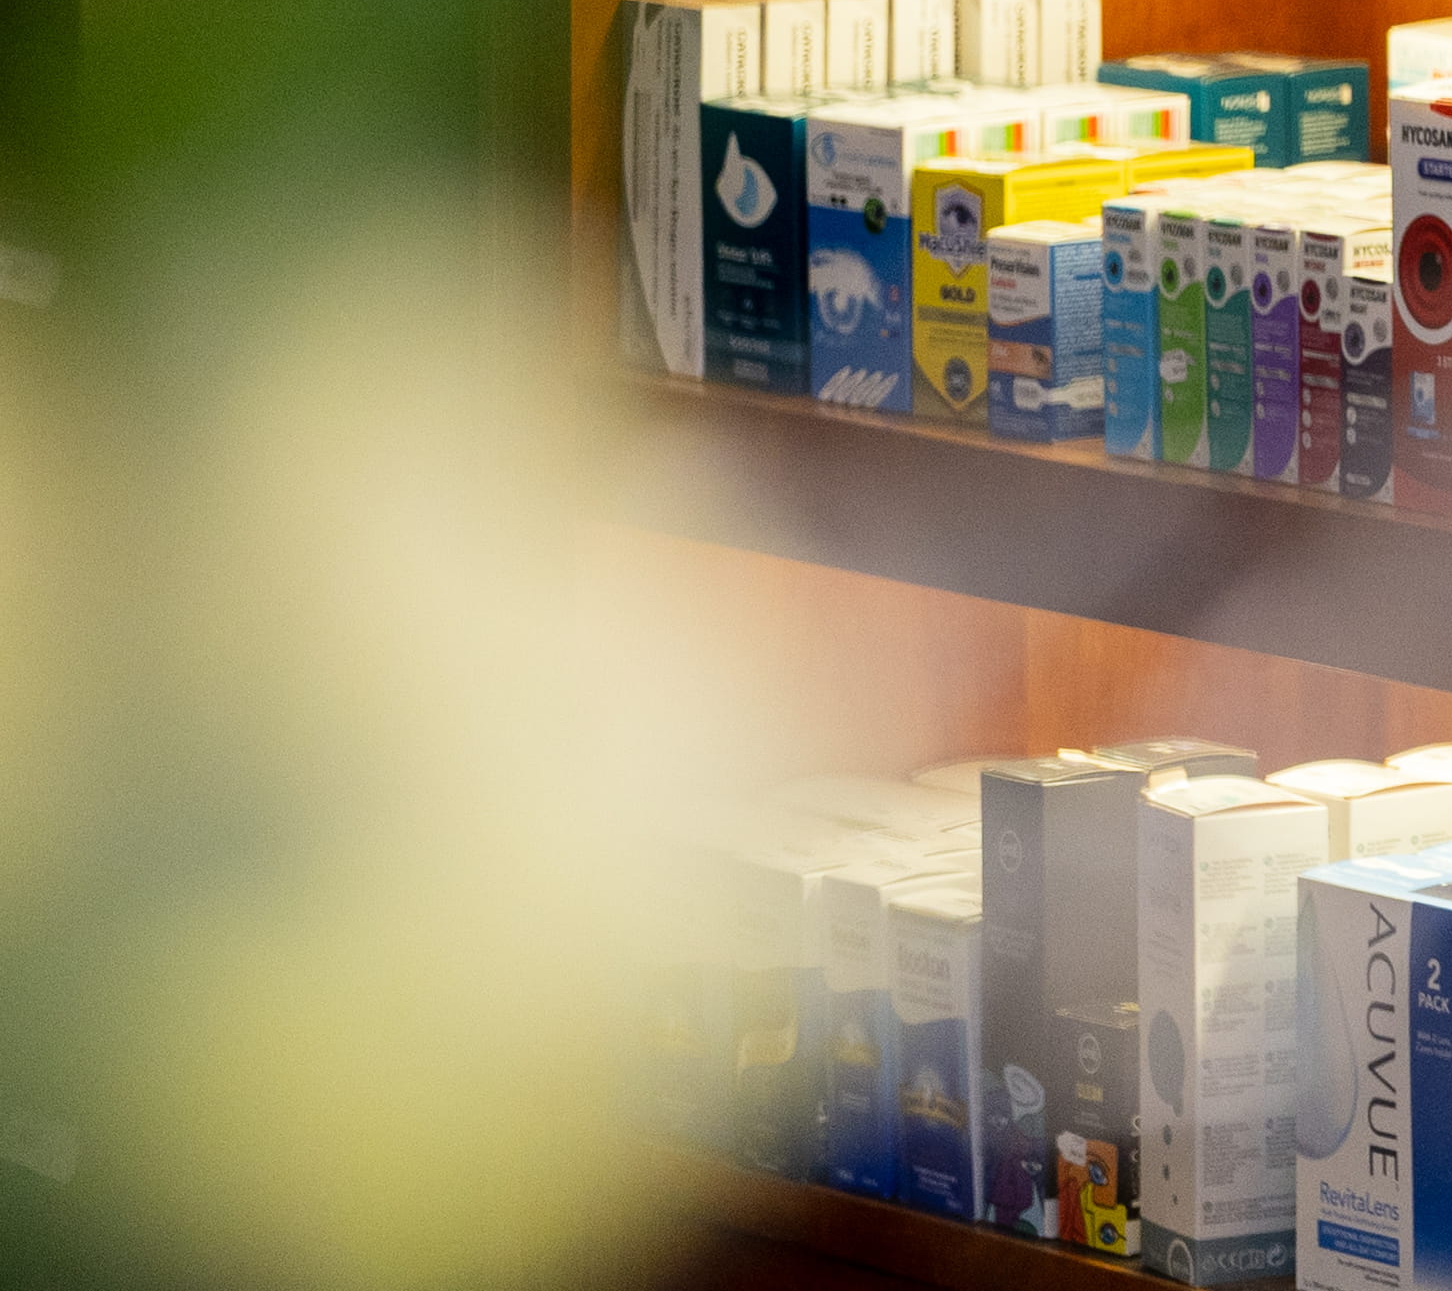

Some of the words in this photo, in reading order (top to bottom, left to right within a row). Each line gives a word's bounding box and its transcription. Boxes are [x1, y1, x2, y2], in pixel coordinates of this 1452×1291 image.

[939, 285, 976, 304] GOLD
[1426, 958, 1442, 992] 2
[1418, 991, 1450, 1014] PACK
[1366, 902, 1399, 1181] ACUVUE
[1320, 1181, 1400, 1221] RevitaLens
